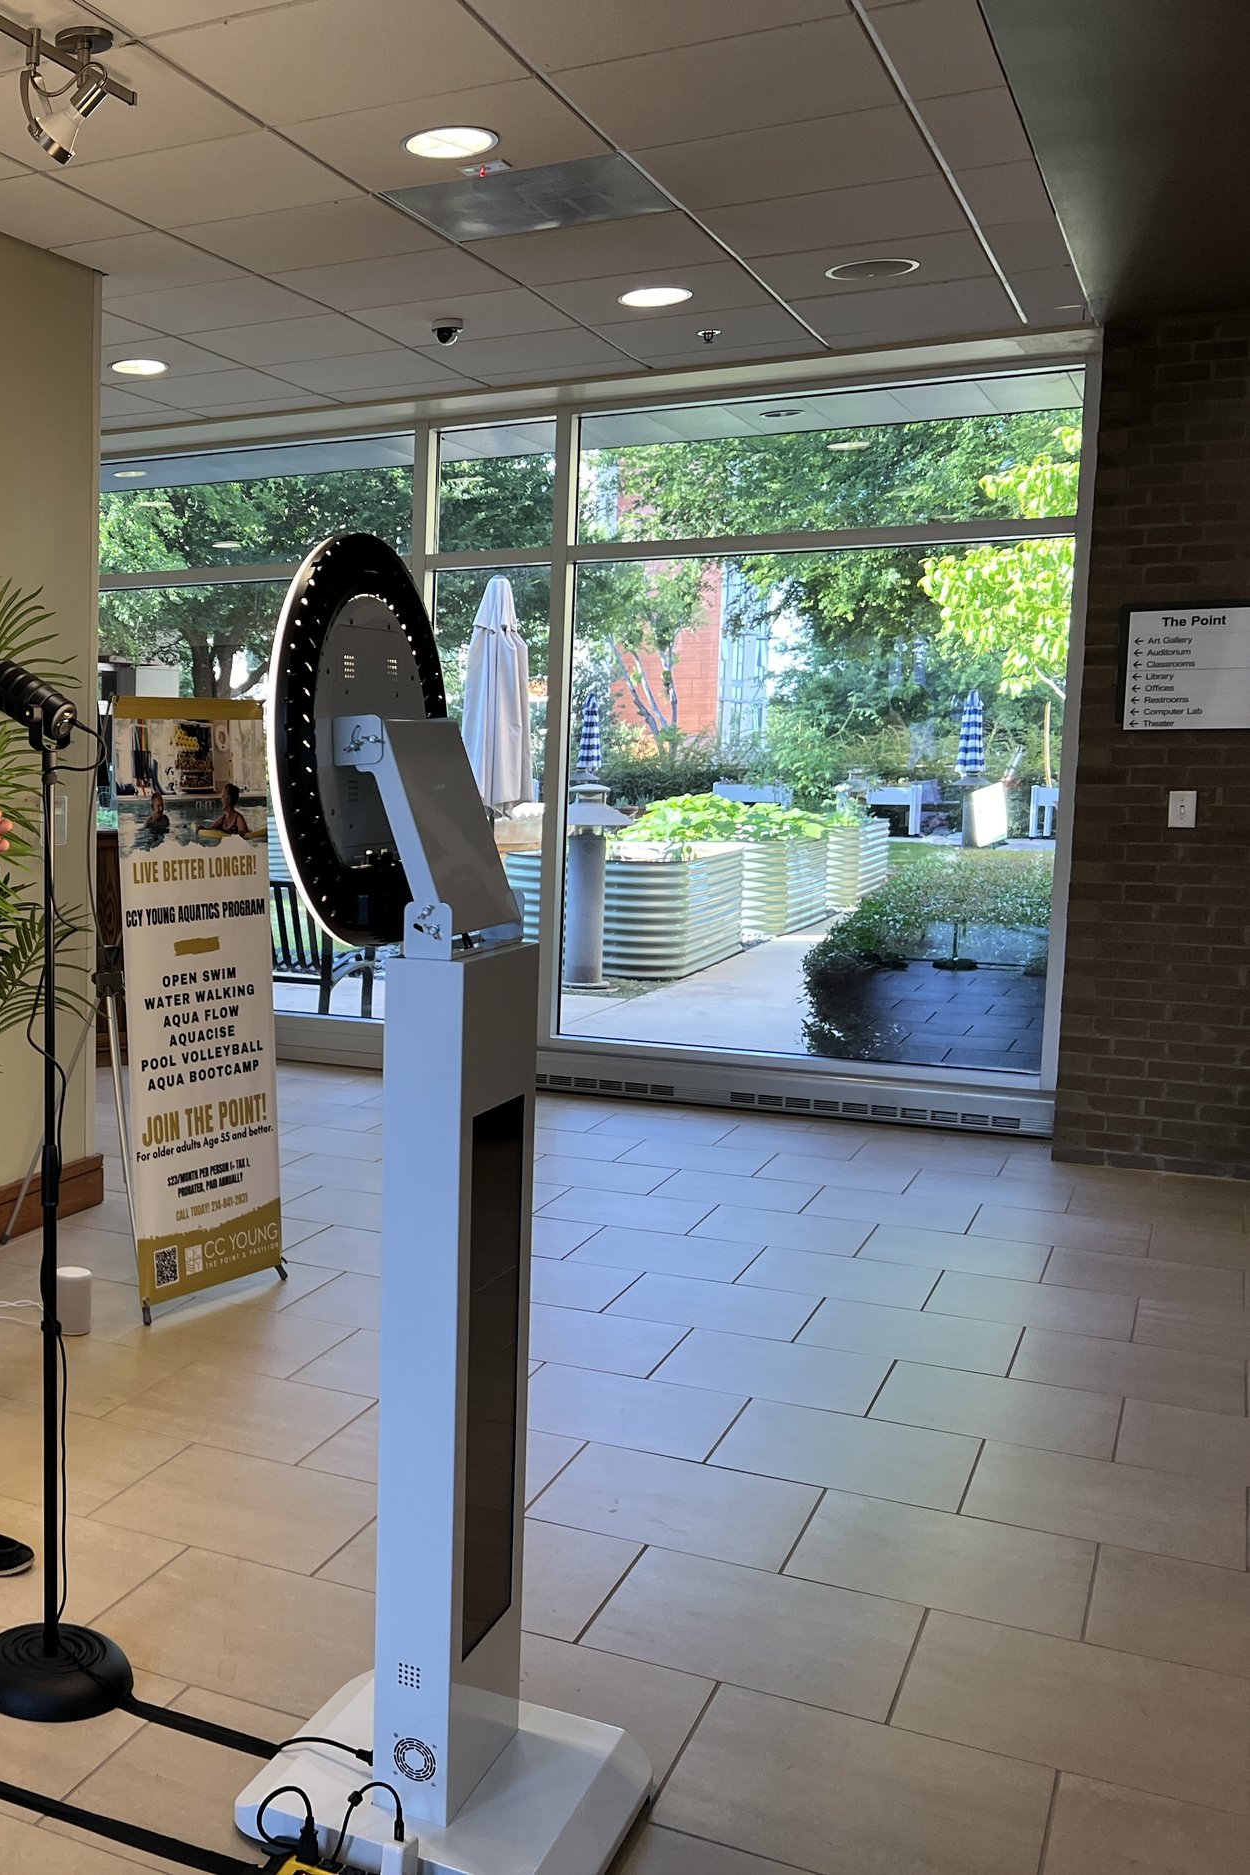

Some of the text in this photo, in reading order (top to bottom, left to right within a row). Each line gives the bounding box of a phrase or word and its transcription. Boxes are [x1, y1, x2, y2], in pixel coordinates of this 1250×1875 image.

[1162, 615, 1227, 627] The Point
[1147, 636, 1193, 645] Art Gallery
[1147, 648, 1191, 656] Auditorium
[1146, 660, 1195, 668] Classrooms
[1145, 672, 1174, 681] Library
[1145, 684, 1174, 692] Offices
[1144, 696, 1189, 704] Restrooms
[1143, 707, 1203, 716] Computer Lab
[133, 855, 257, 884] LIVE BETTER LONGER!
[126, 898, 265, 928] CCY YOUNG AQUATICS PROGRAM
[162, 967, 236, 987] OPEN SWIM
[144, 984, 255, 1010] WATER WALKING
[163, 1005, 239, 1028] AQUA FLOW
[169, 1025, 235, 1047] AQUACISE
[141, 1040, 263, 1072] POOL VOLLEYBALL
[148, 1059, 259, 1091] AQUA BOOTCAMP
[142, 1093, 267, 1147] JOIN THE POINT!
[136, 1124, 274, 1163] For older adults Age 55 and better.
[199, 1167, 209, 1178] PER
[210, 1162, 229, 1176] PERSON
[236, 1158, 245, 1169] TAX
[206, 1178, 217, 1191] PAID
[175, 1208, 189, 1221] CALL
[204, 1222, 278, 1258] CC YOUNG
[220, 1253, 239, 1264] POINT
[250, 1242, 279, 1256] PAVILION
